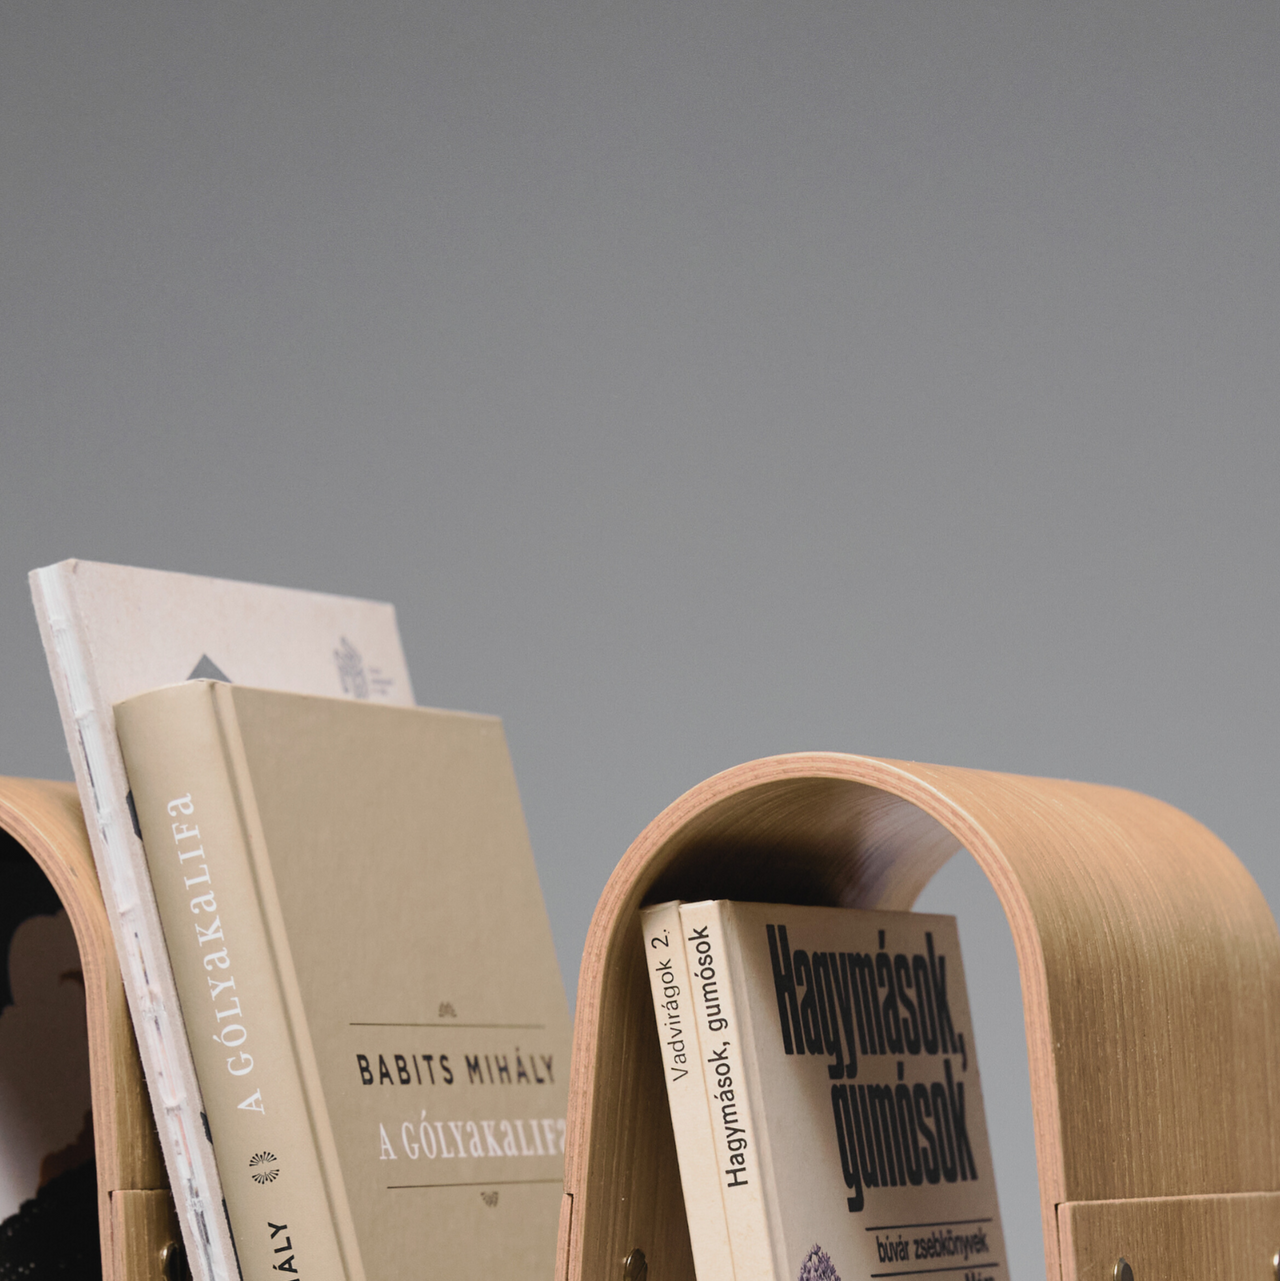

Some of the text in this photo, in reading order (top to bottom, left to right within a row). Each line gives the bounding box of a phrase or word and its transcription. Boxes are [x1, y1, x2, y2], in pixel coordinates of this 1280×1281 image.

[651, 929, 689, 1082] Vadvirágok 2.
[766, 924, 967, 1080] Hagymások,
[237, 1088, 265, 1115] A
[356, 1046, 554, 1086] BABITS MIHÁLY
[688, 925, 748, 1188] Hagymások, gumósok
[379, 1122, 398, 1160] A
[831, 1058, 979, 1213] gumósok
[876, 1226, 990, 1263] búvár zsebkönyvek
